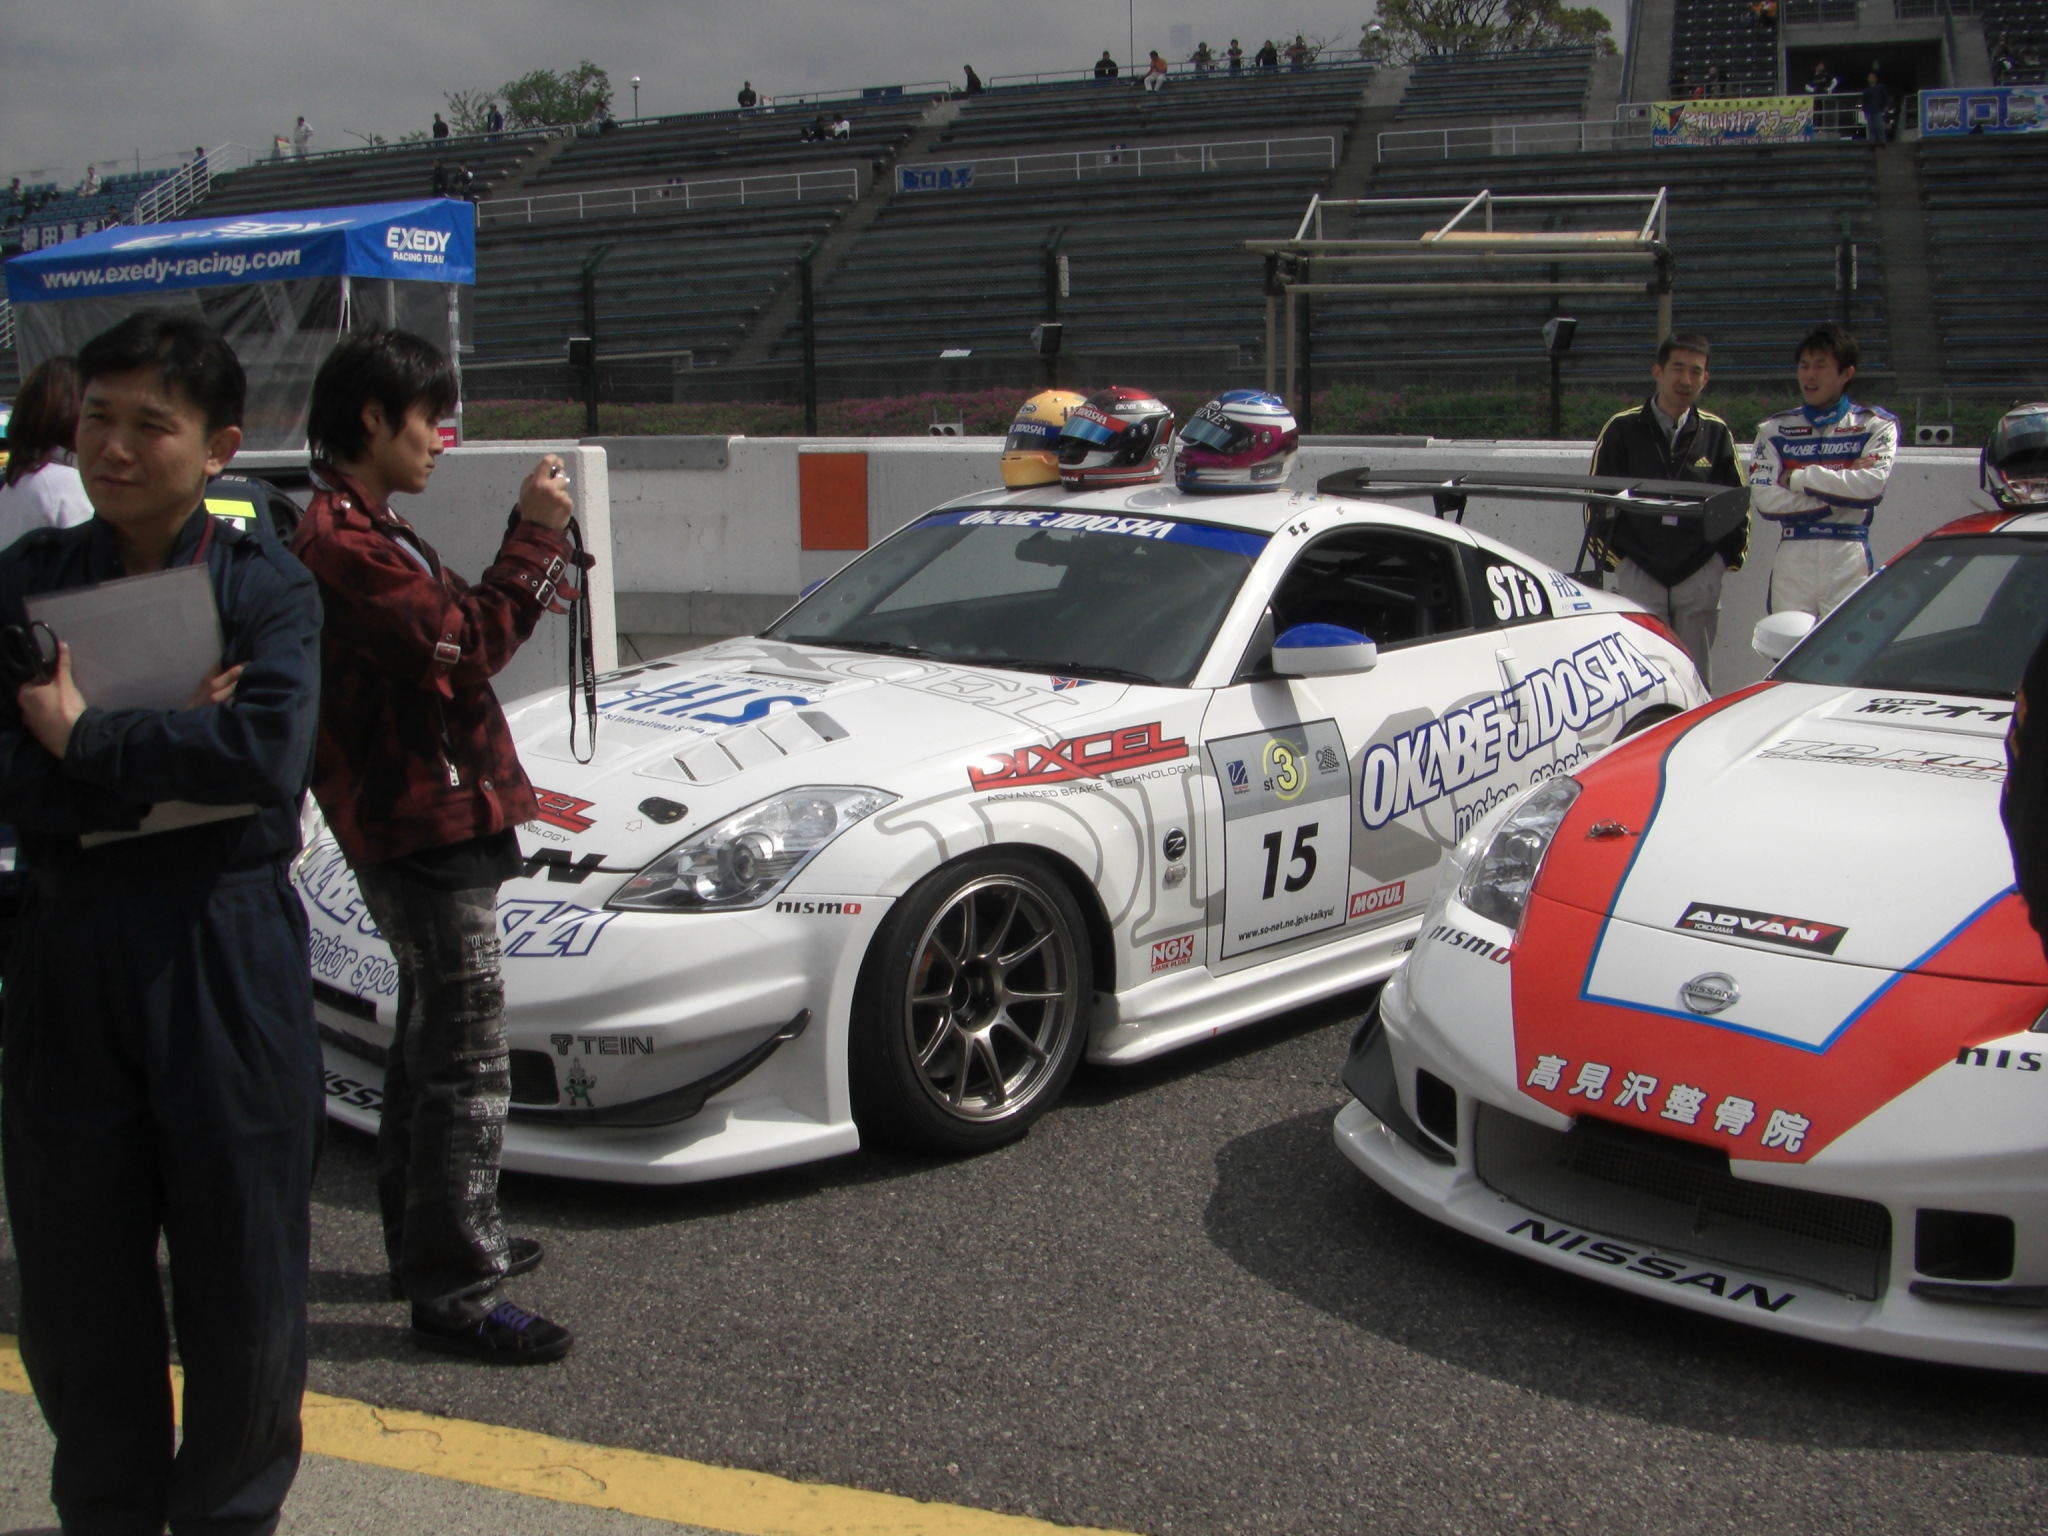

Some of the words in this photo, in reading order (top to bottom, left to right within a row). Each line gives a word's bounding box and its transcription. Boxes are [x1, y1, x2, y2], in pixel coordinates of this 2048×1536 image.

[386, 227, 452, 252] EXEDY
[42, 248, 301, 289] www.exedy-racing.com
[393, 251, 422, 262] RACING
[424, 254, 445, 264] TEAM
[959, 510, 1055, 526] OKABE
[1040, 512, 1176, 540] JIDOSHA
[1486, 566, 1543, 621] ST3
[1361, 694, 1501, 831] OKABE
[1500, 631, 1668, 762] JIDOSHA
[967, 720, 1189, 793] DIXCEL
[1272, 746, 1299, 791] 3
[986, 788, 1059, 802] ADVANCED
[1060, 782, 1104, 796] BRAKE
[1106, 763, 1195, 788] TECHNOLOGY
[1262, 822, 1319, 900] 15
[776, 901, 862, 914] nismo
[1353, 884, 1403, 914] MOTUL
[1686, 910, 1819, 941] ADVAN
[1694, 923, 1734, 934] YOKOHAMA
[1152, 936, 1192, 966] NGK
[1428, 925, 1516, 964] nismo
[1686, 984, 1732, 999] NISSAN
[577, 1036, 655, 1055] TEIN
[1527, 1054, 1811, 1153] 高見沢整骨院
[1505, 1218, 1797, 1312] NISSAN
